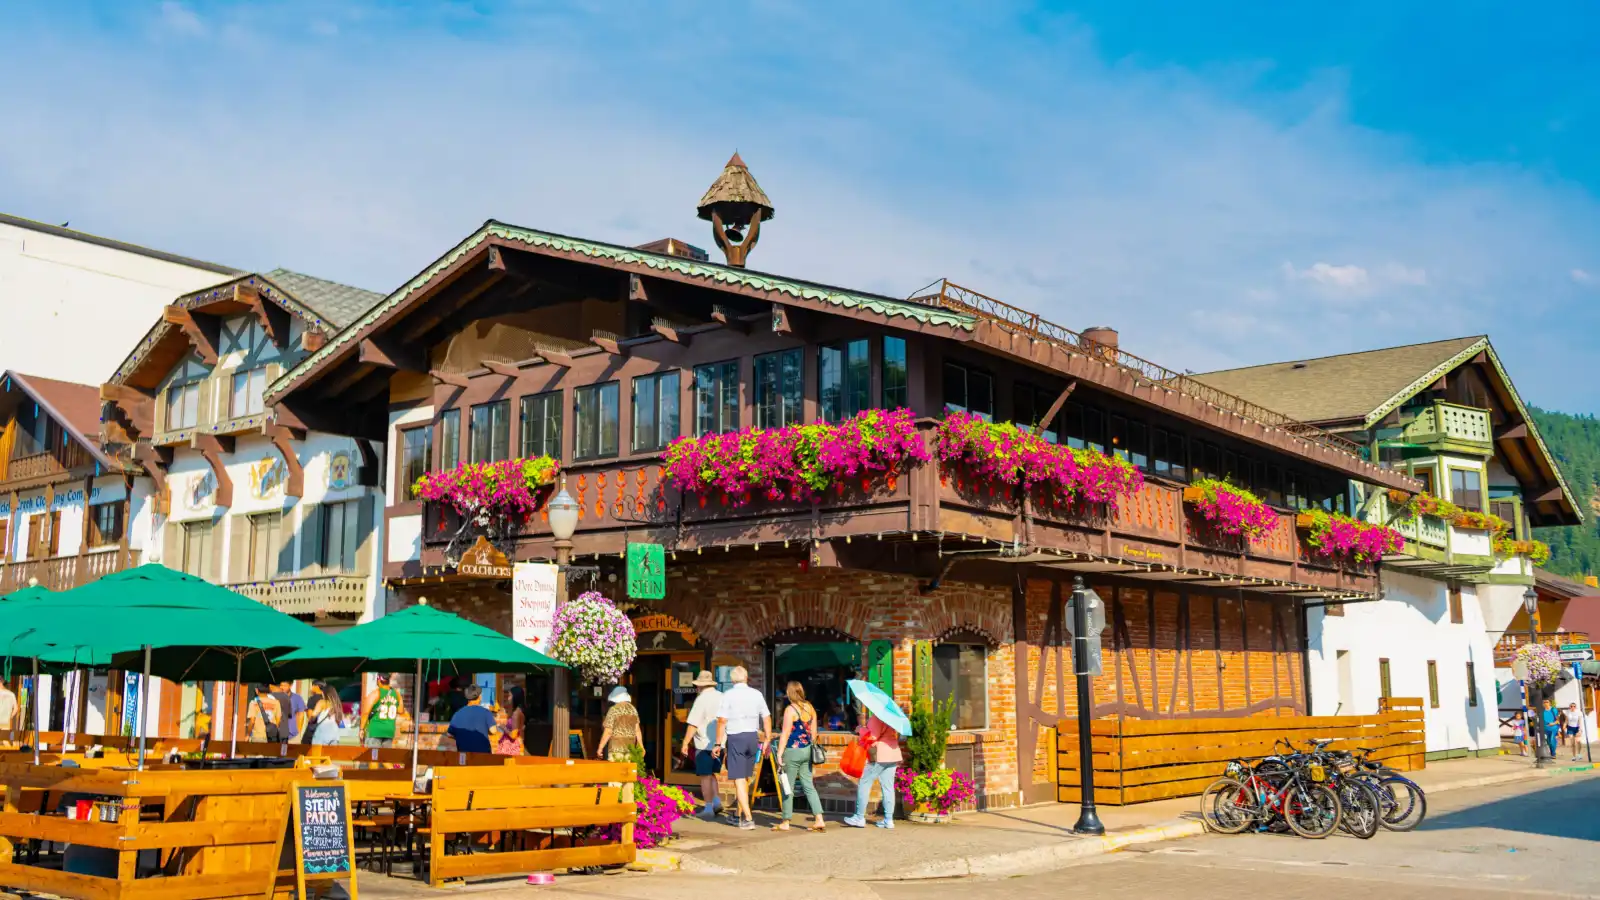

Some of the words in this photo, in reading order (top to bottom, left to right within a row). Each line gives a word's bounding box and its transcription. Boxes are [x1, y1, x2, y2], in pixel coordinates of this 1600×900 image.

[36, 492, 65, 508] Cloing
[67, 487, 102, 502] Comny
[632, 580, 662, 594] STEIN
[379, 704, 397, 720] 20
[305, 811, 338, 824] PATIO
[313, 825, 327, 837] PICK
